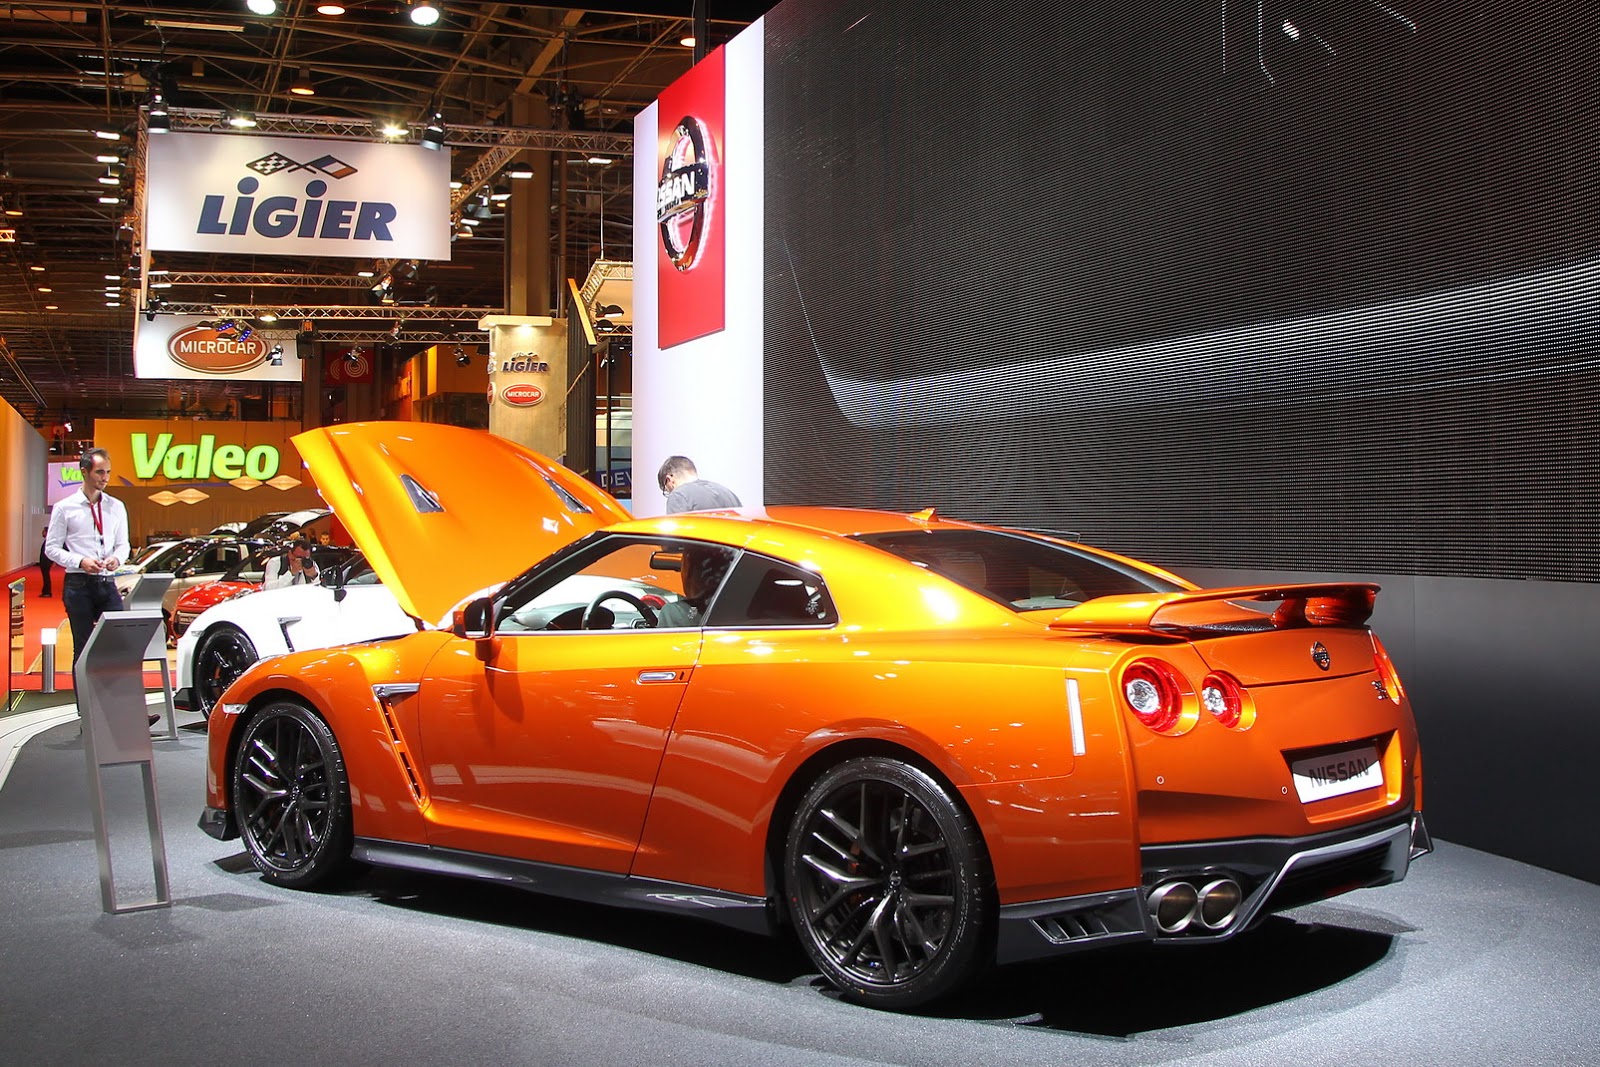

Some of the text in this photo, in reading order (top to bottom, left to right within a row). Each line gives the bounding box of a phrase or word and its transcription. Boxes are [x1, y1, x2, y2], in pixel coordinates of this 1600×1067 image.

[180, 340, 257, 355] MICROCAR
[131, 432, 279, 480] Valeo
[1309, 757, 1369, 788] NISSAN
